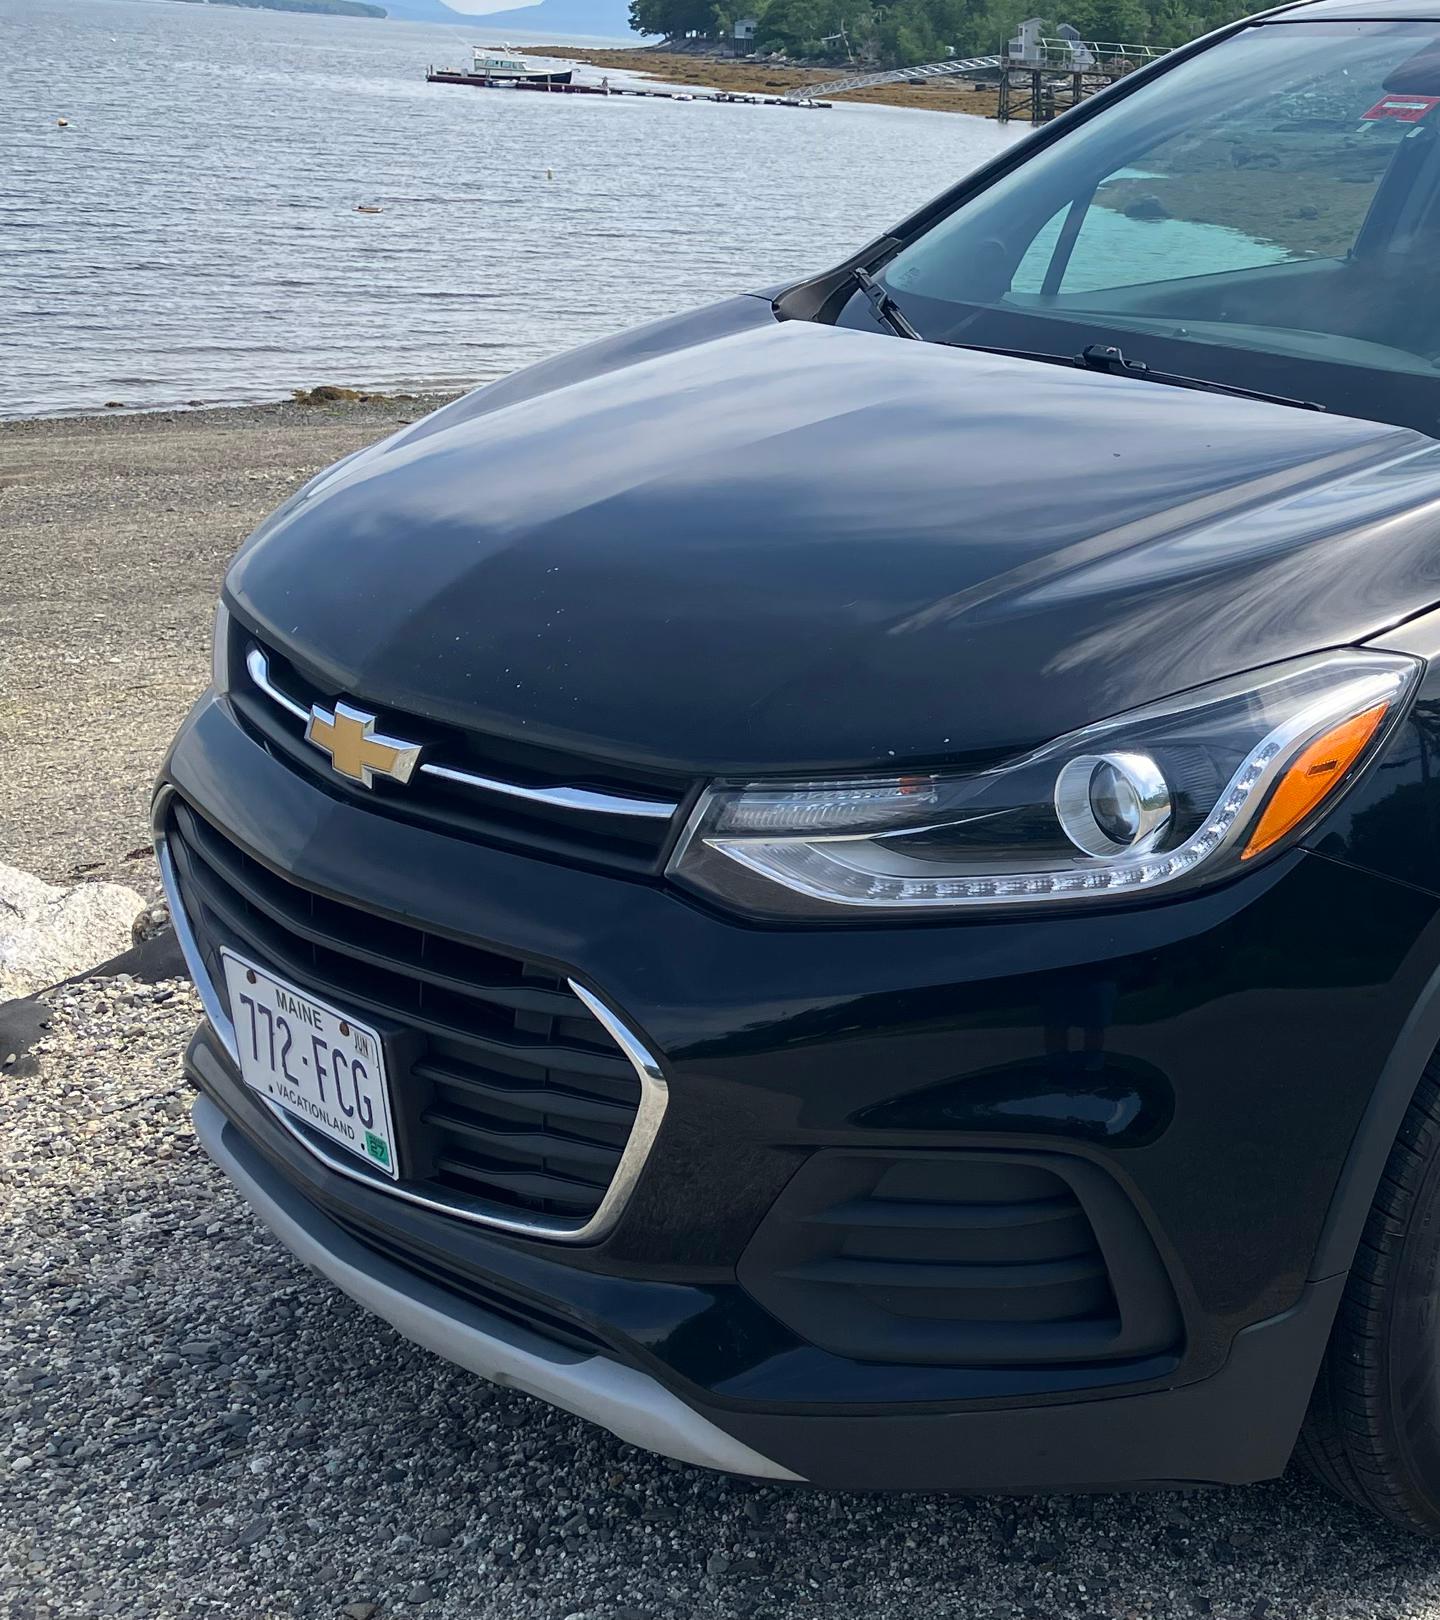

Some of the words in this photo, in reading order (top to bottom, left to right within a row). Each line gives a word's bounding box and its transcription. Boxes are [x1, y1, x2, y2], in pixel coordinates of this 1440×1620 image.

[275, 990, 323, 1031] MAINE
[354, 1031, 369, 1056] JUN
[277, 1083, 355, 1140] VACATIONLAND
[369, 1139, 385, 1158] 27
